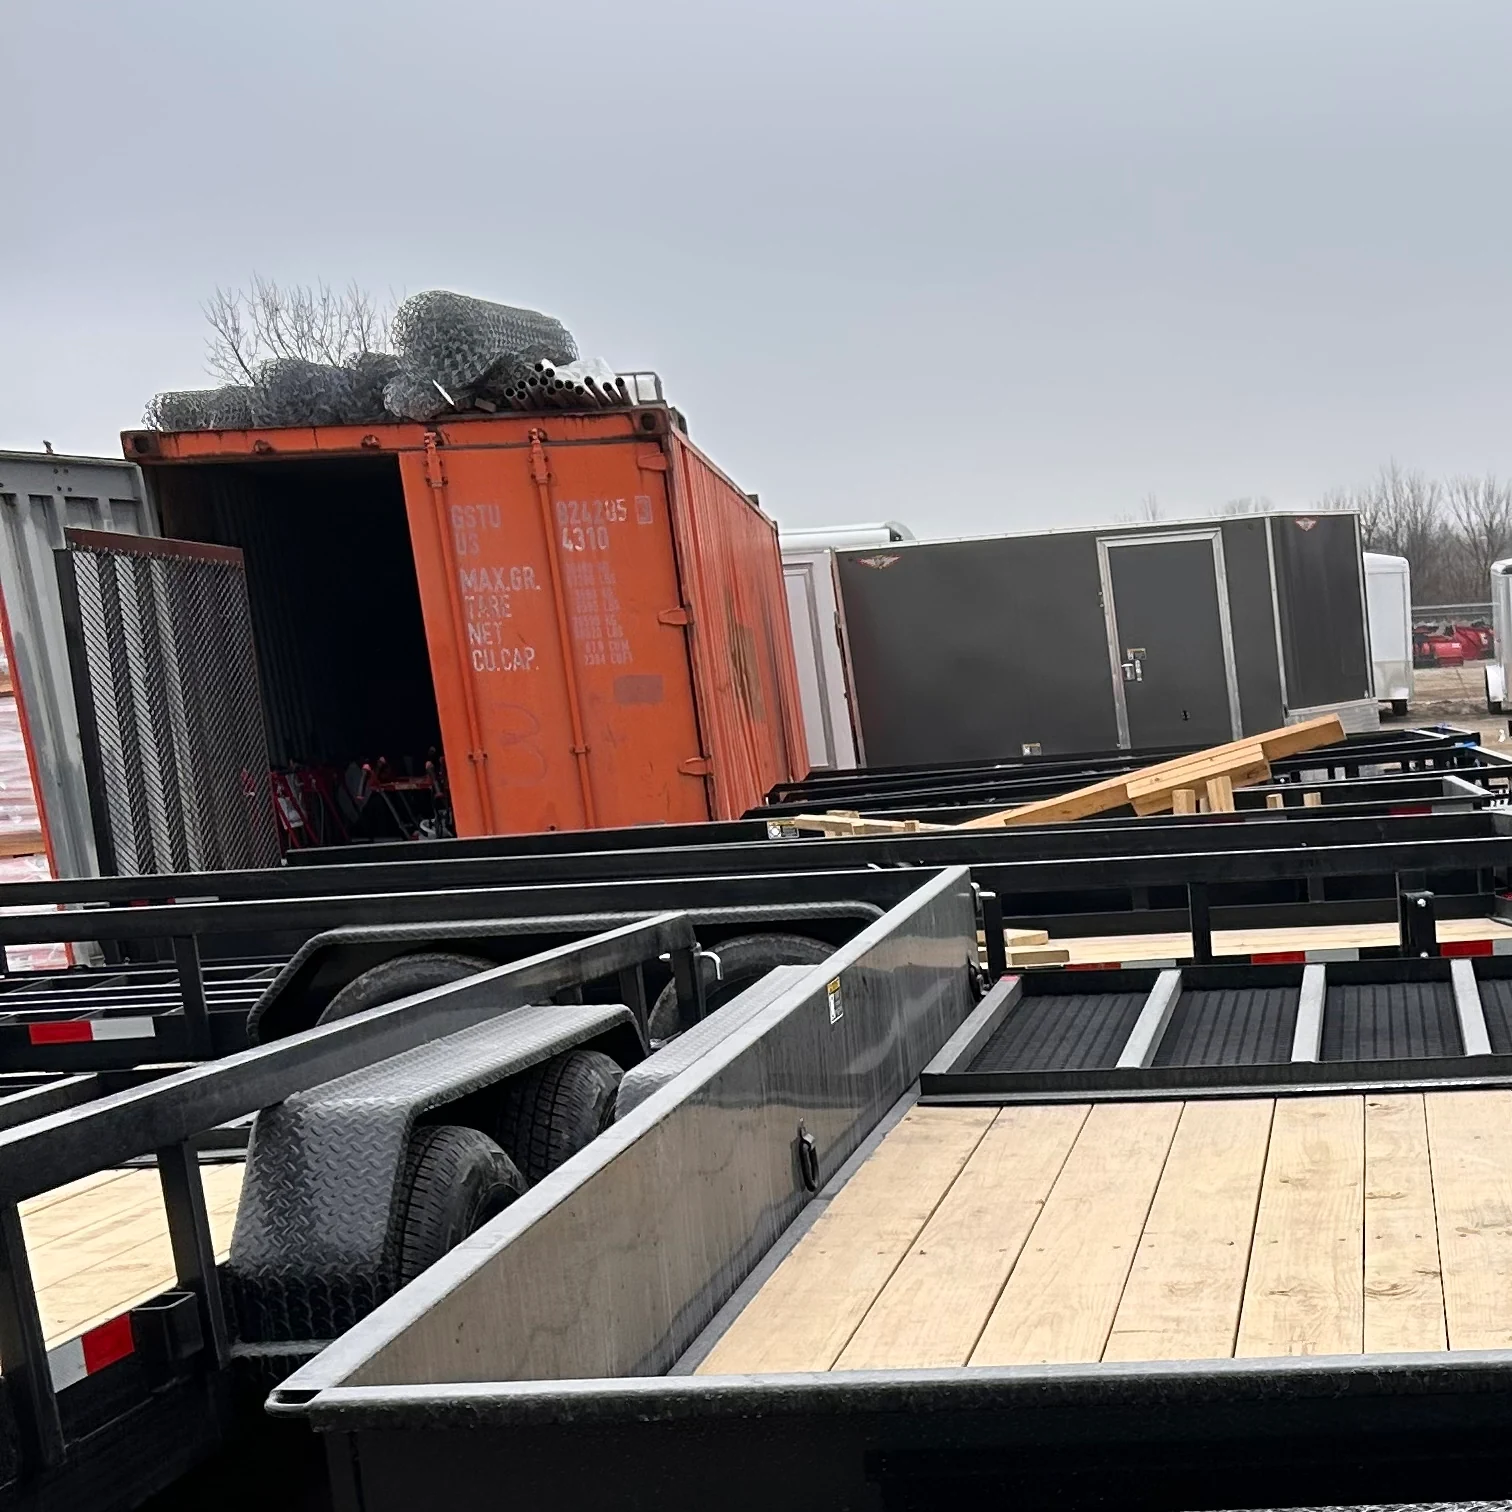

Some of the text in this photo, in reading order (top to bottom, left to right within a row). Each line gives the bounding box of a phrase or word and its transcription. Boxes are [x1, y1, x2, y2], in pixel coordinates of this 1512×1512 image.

[451, 504, 501, 529] GSTU
[562, 526, 610, 552] 4310
[459, 566, 541, 594] MAX.GR.
[464, 594, 512, 619] TARE
[468, 621, 502, 645] NET
[472, 647, 540, 672] CU.CAP.
